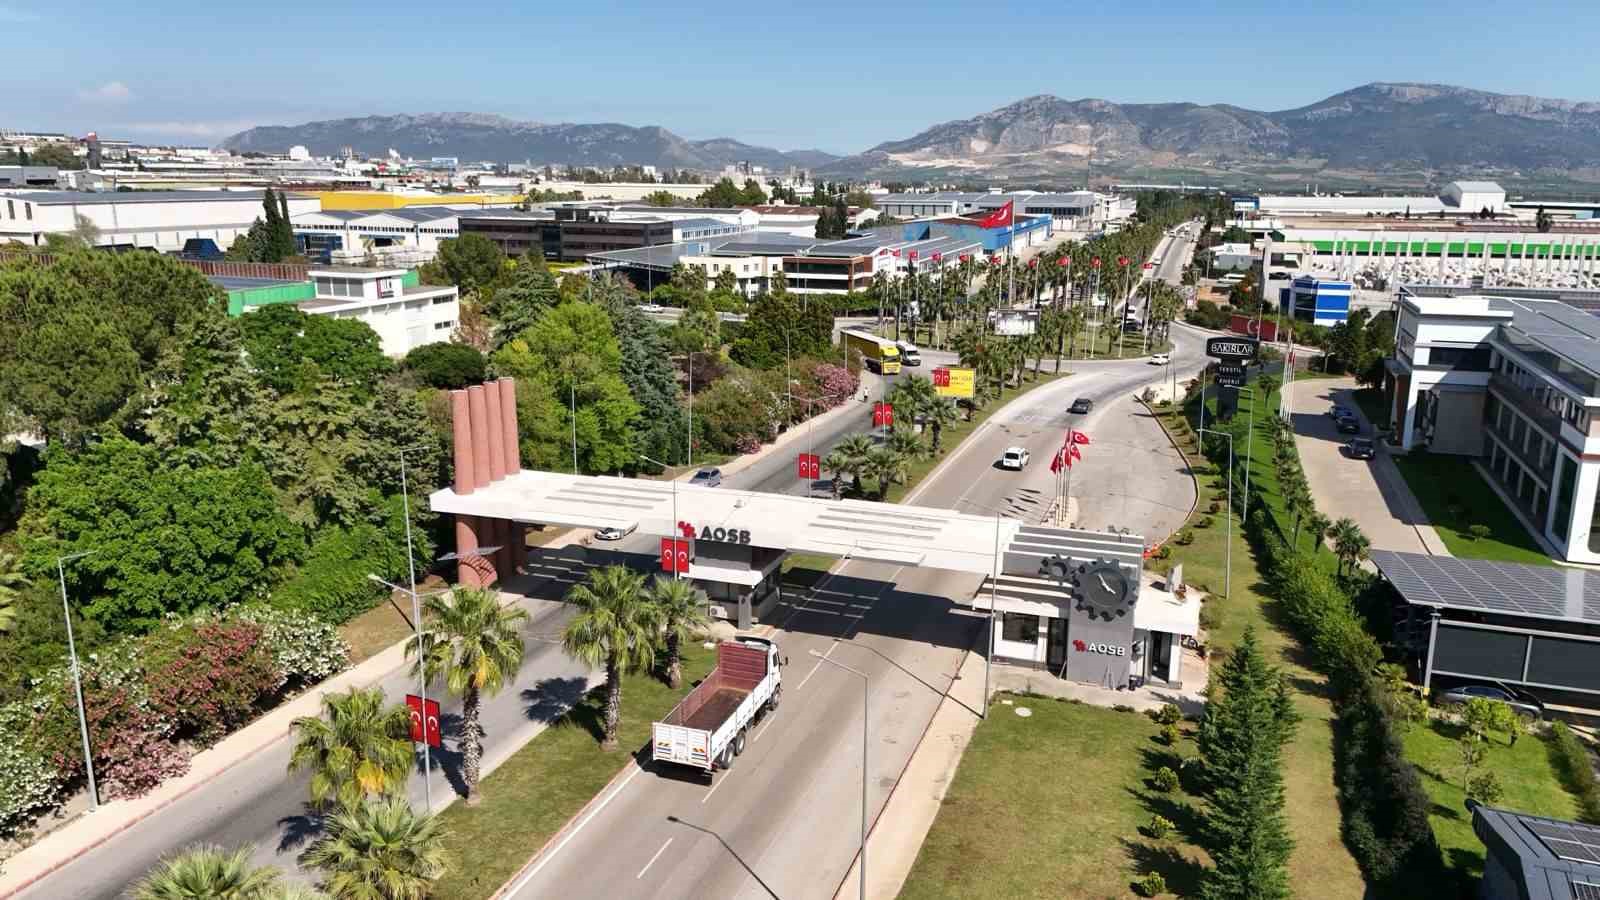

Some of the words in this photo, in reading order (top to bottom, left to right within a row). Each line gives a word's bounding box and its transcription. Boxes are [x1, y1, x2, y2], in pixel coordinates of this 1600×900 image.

[1211, 343, 1254, 353] BAKIRLAR
[701, 525, 751, 544] AOSB
[1088, 643, 1125, 656] AOSB
